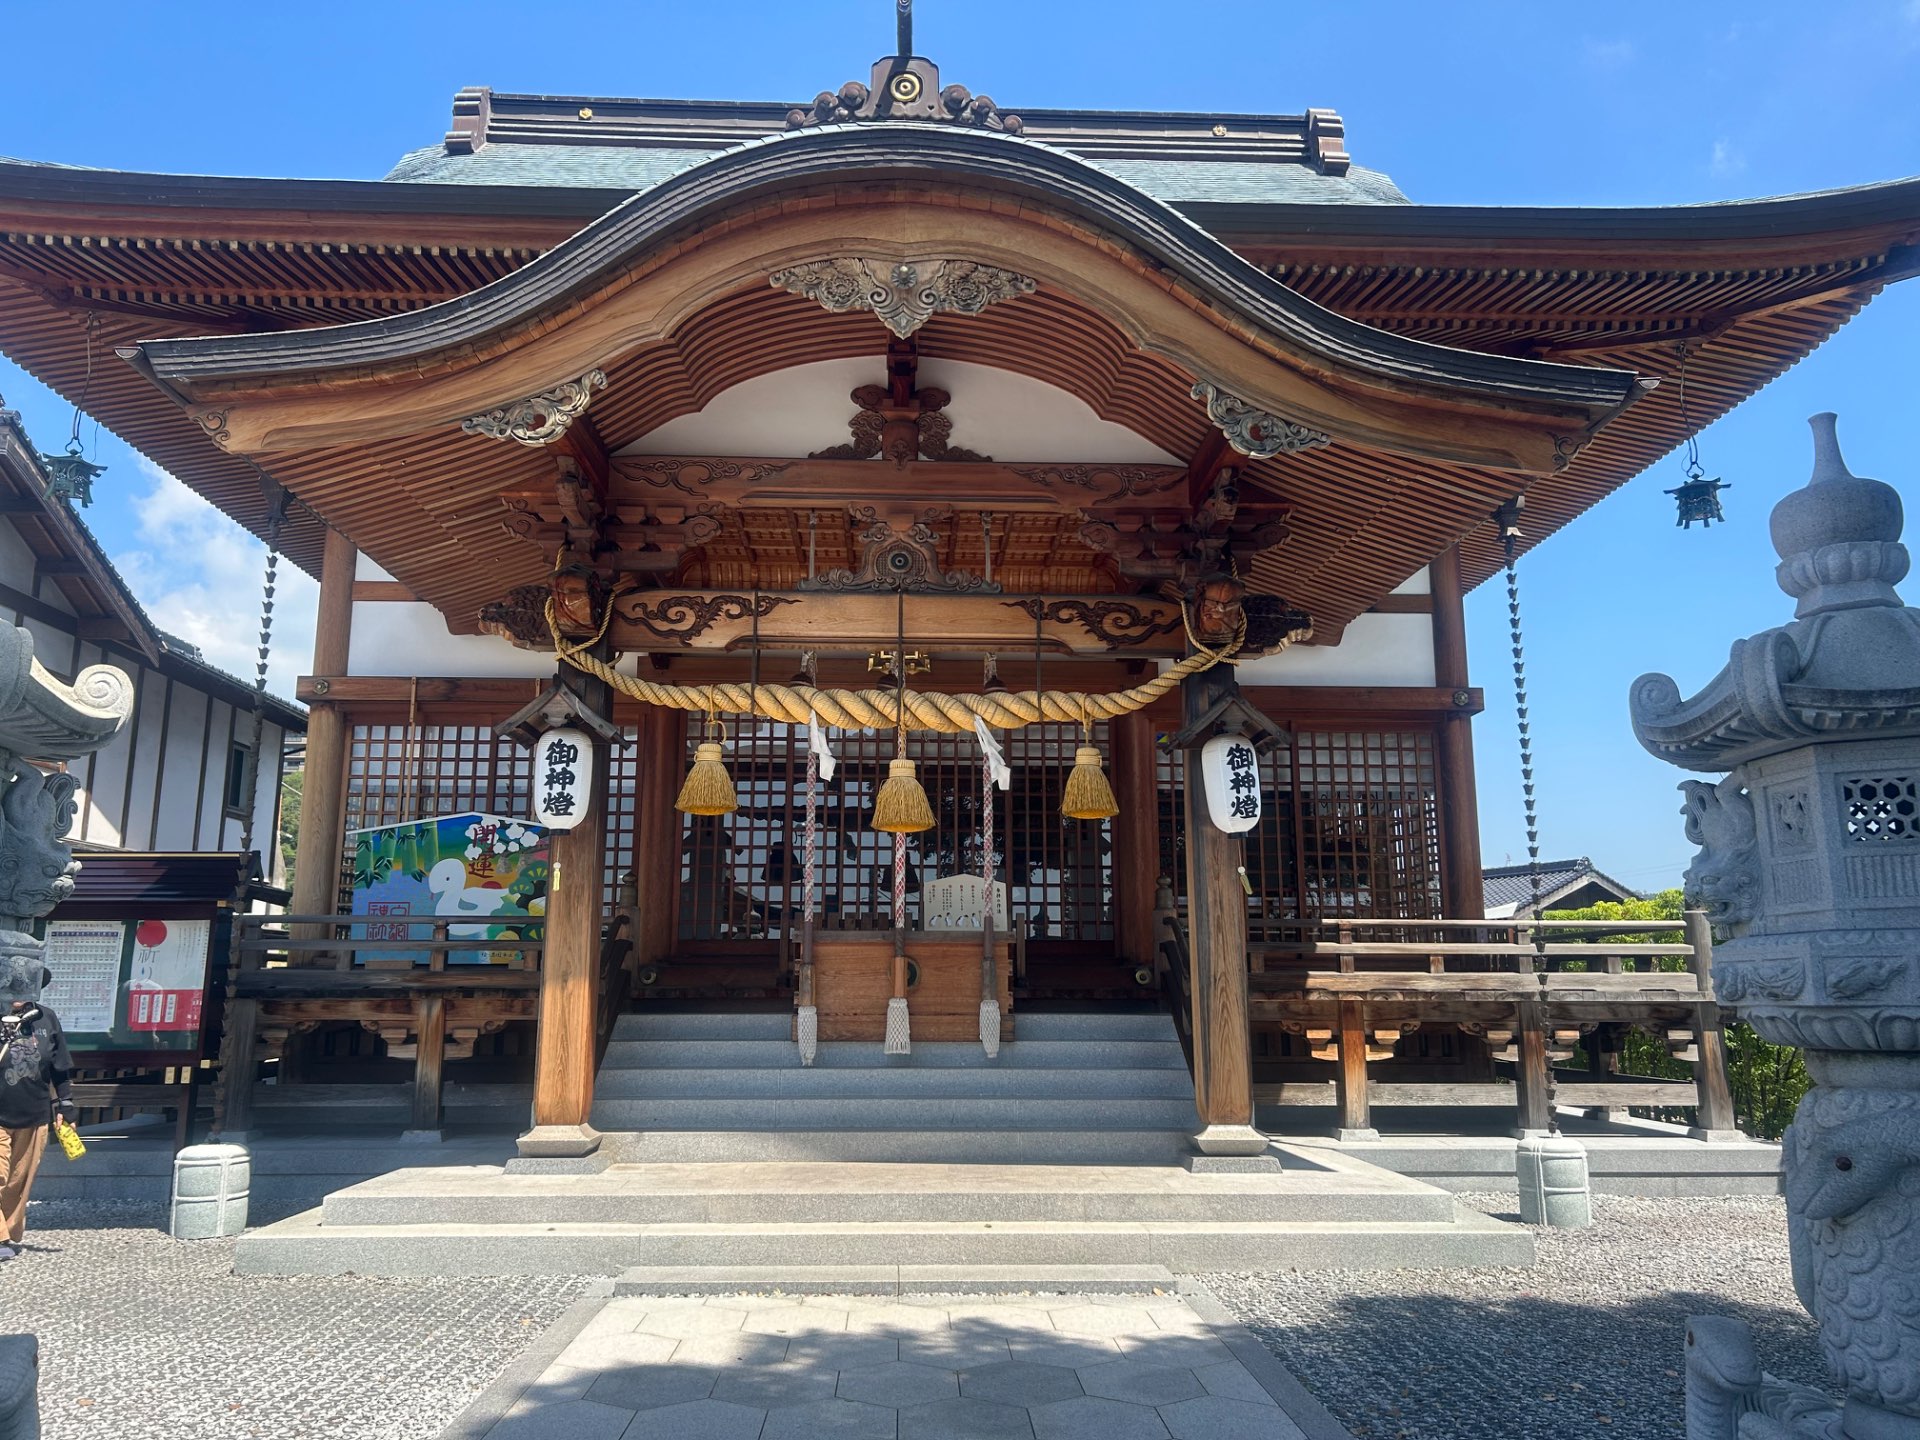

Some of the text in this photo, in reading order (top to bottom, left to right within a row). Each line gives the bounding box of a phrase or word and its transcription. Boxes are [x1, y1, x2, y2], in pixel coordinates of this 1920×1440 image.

[543, 738, 578, 817] 御神燈
[1226, 743, 1259, 819] 御神燈
[468, 823, 497, 879] 開運
[137, 949, 160, 980] 祈り
